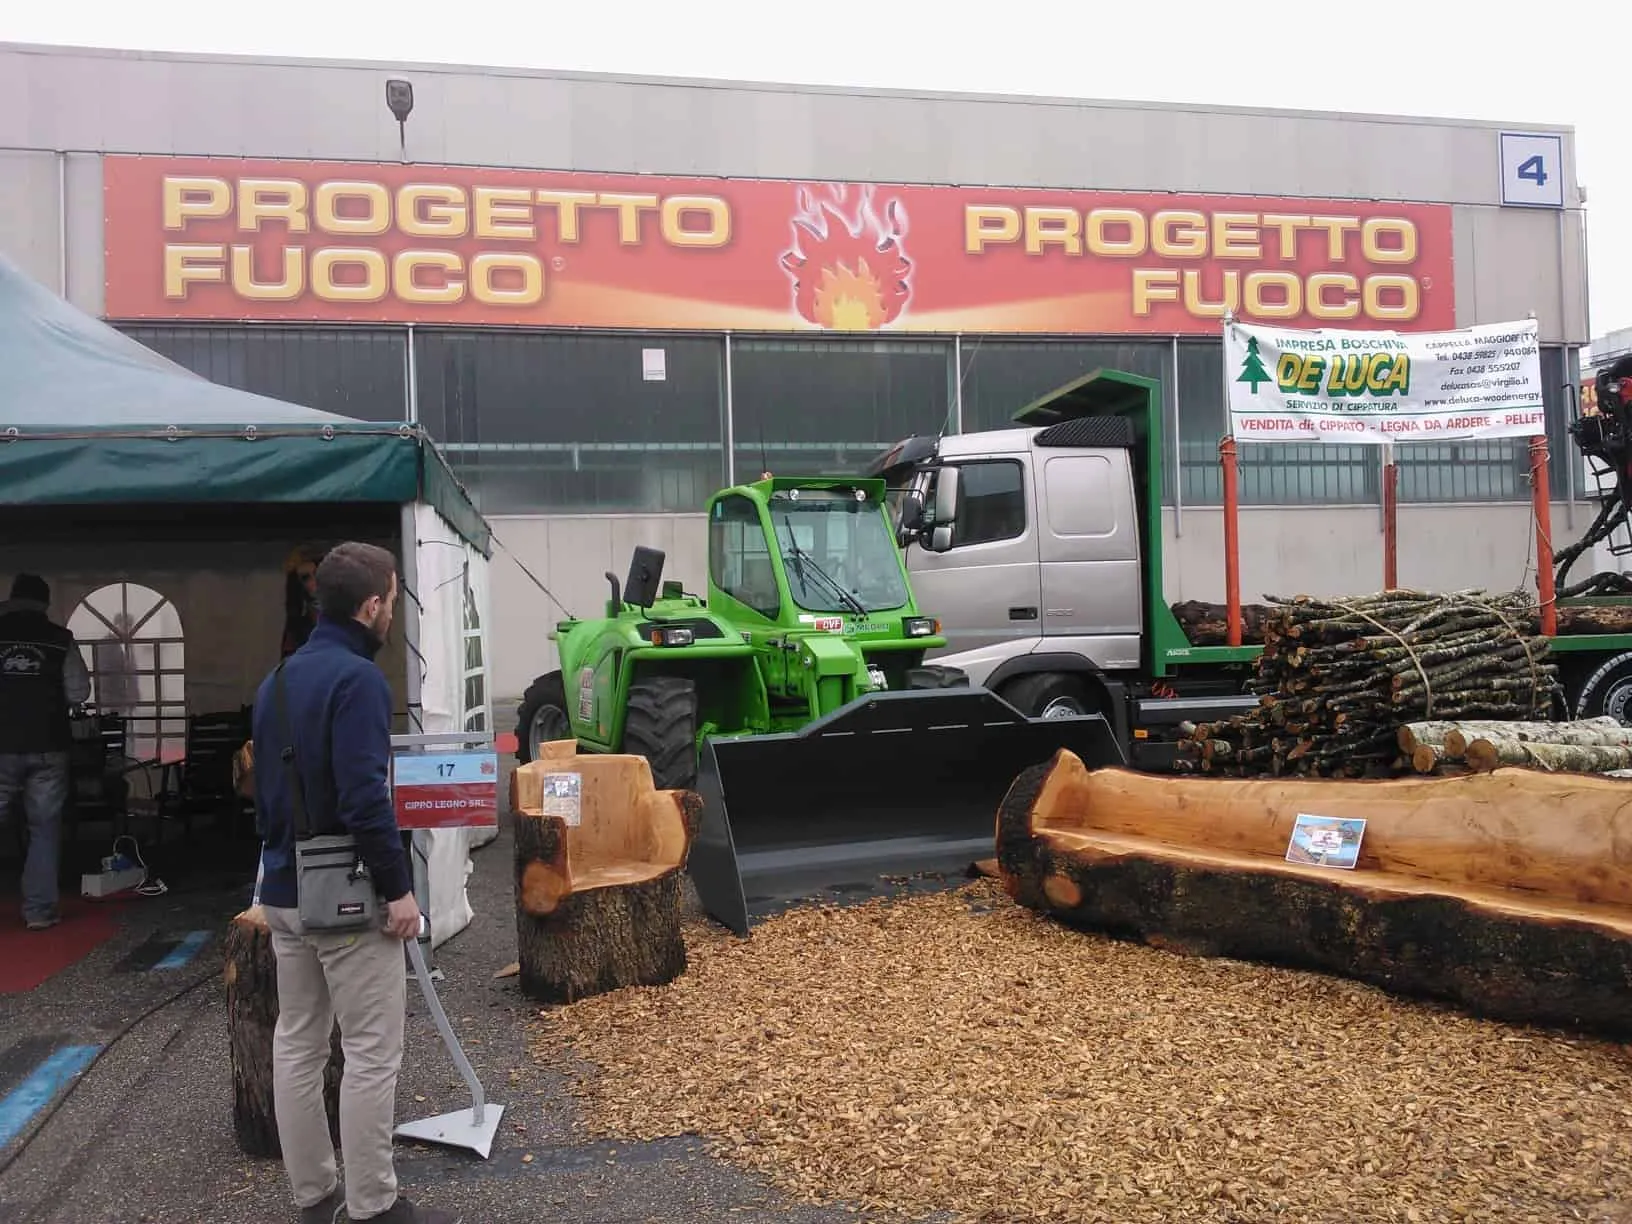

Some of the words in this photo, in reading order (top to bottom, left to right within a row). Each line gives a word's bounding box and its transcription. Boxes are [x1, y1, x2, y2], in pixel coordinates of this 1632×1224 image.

[1518, 155, 1548, 186] 4
[163, 177, 733, 248] PROGETTO
[965, 204, 1418, 264] PROGETTO
[164, 244, 545, 305] FUOCO
[1133, 268, 1420, 320] FUOCO
[1276, 338, 1336, 351] IMPRESA
[1341, 339, 1408, 350] BOSCHIVA
[1276, 353, 1327, 395] DE
[1327, 353, 1411, 397] LUCA
[1450, 367, 1464, 375] Fax
[1286, 399, 1328, 411] SERVIZIO
[1332, 402, 1343, 411] DI
[1347, 402, 1398, 411] CIPPATURA
[1241, 418, 1294, 431] VENDITA
[1319, 418, 1365, 432] CIPPATO
[1380, 420, 1420, 432] LEGNA
[1424, 419, 1442, 430] DA
[1446, 416, 1491, 429] ARDERE
[1505, 412, 1544, 425] PELLET
[436, 763, 456, 777] 17
[434, 799, 467, 809] LEGNO
